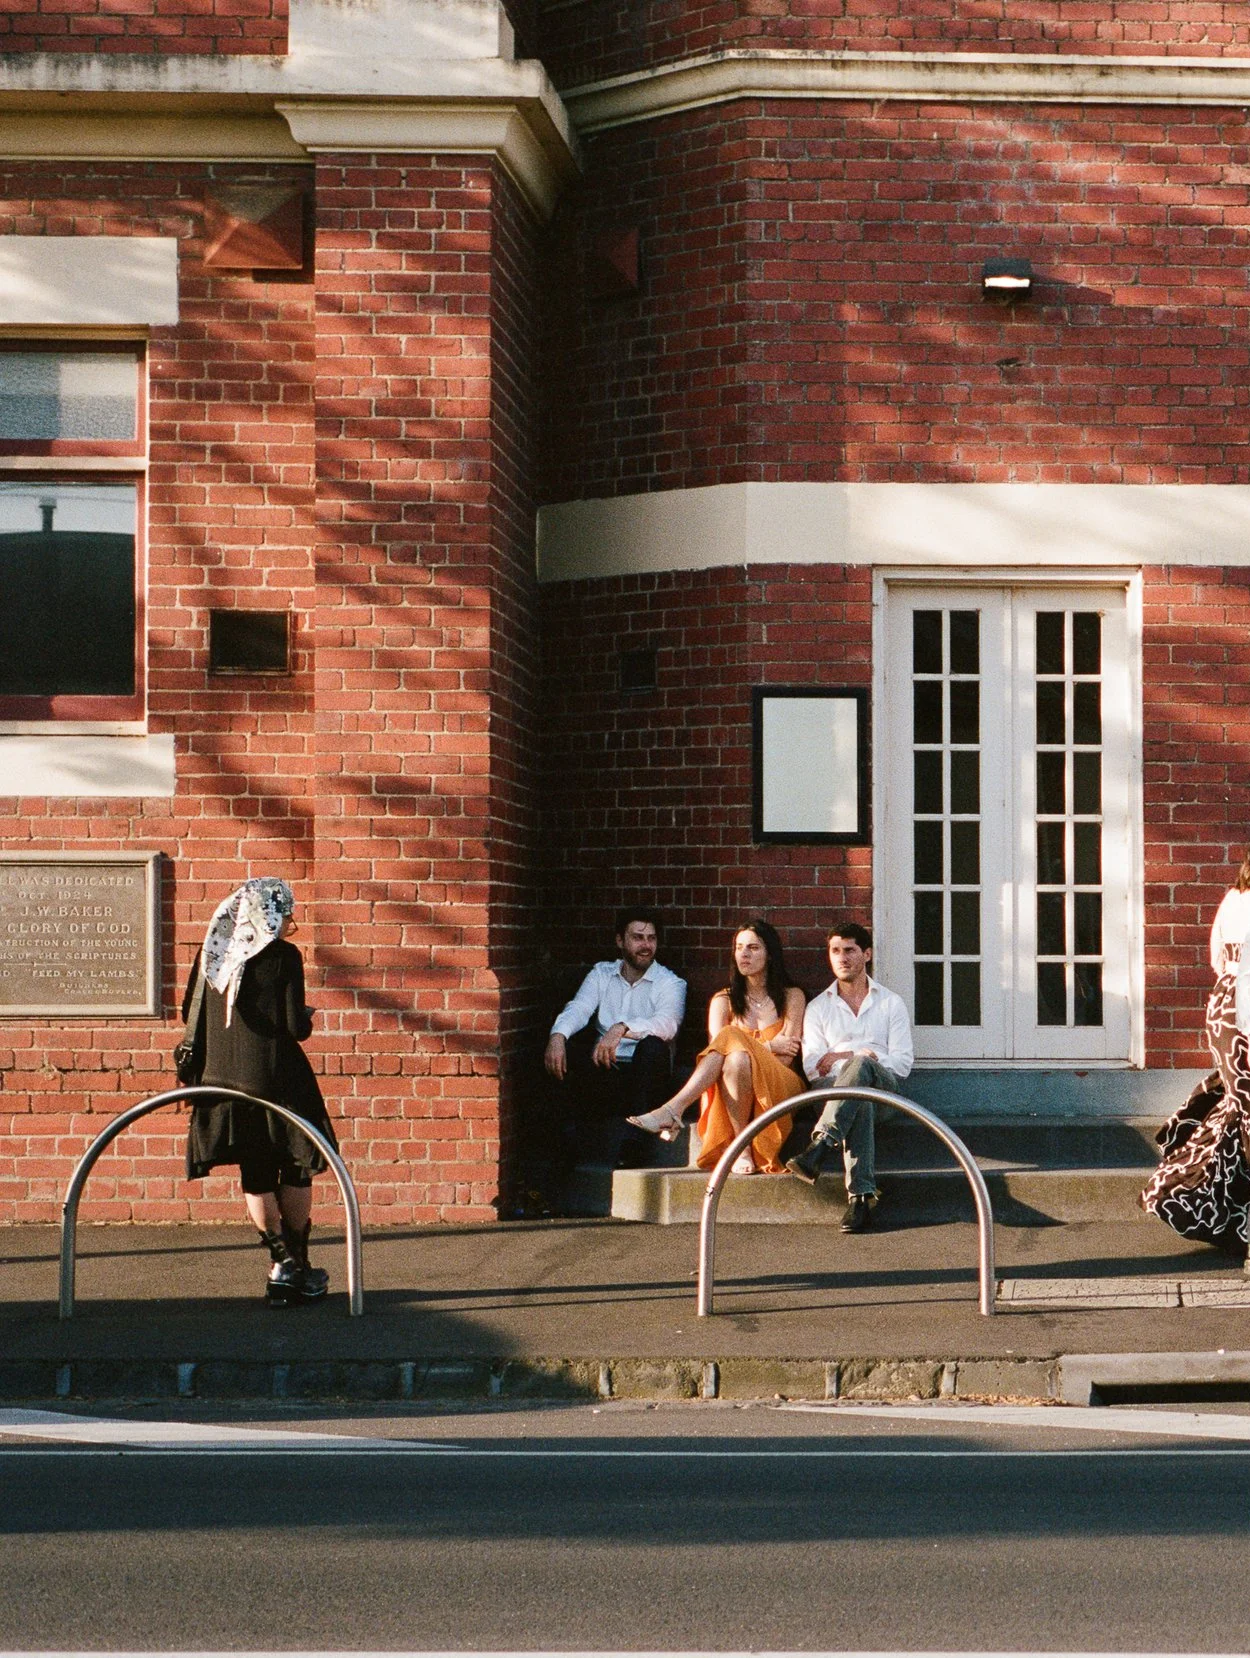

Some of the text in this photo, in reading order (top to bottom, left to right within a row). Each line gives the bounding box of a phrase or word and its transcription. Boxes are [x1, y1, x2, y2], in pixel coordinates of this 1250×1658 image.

[20, 877, 49, 886] WAS
[55, 876, 134, 886] DEDICATED
[58, 890, 92, 900] 1924
[59, 906, 113, 917] BAKER
[7, 921, 132, 934] GLORY OF GOD
[62, 939, 77, 948] OF
[81, 939, 101, 948] THE
[104, 938, 138, 948] YOUNG
[18, 952, 32, 960] OF
[38, 952, 60, 960] THE
[65, 952, 137, 960] SCRIPTURES
[66, 969, 85, 978] MY
